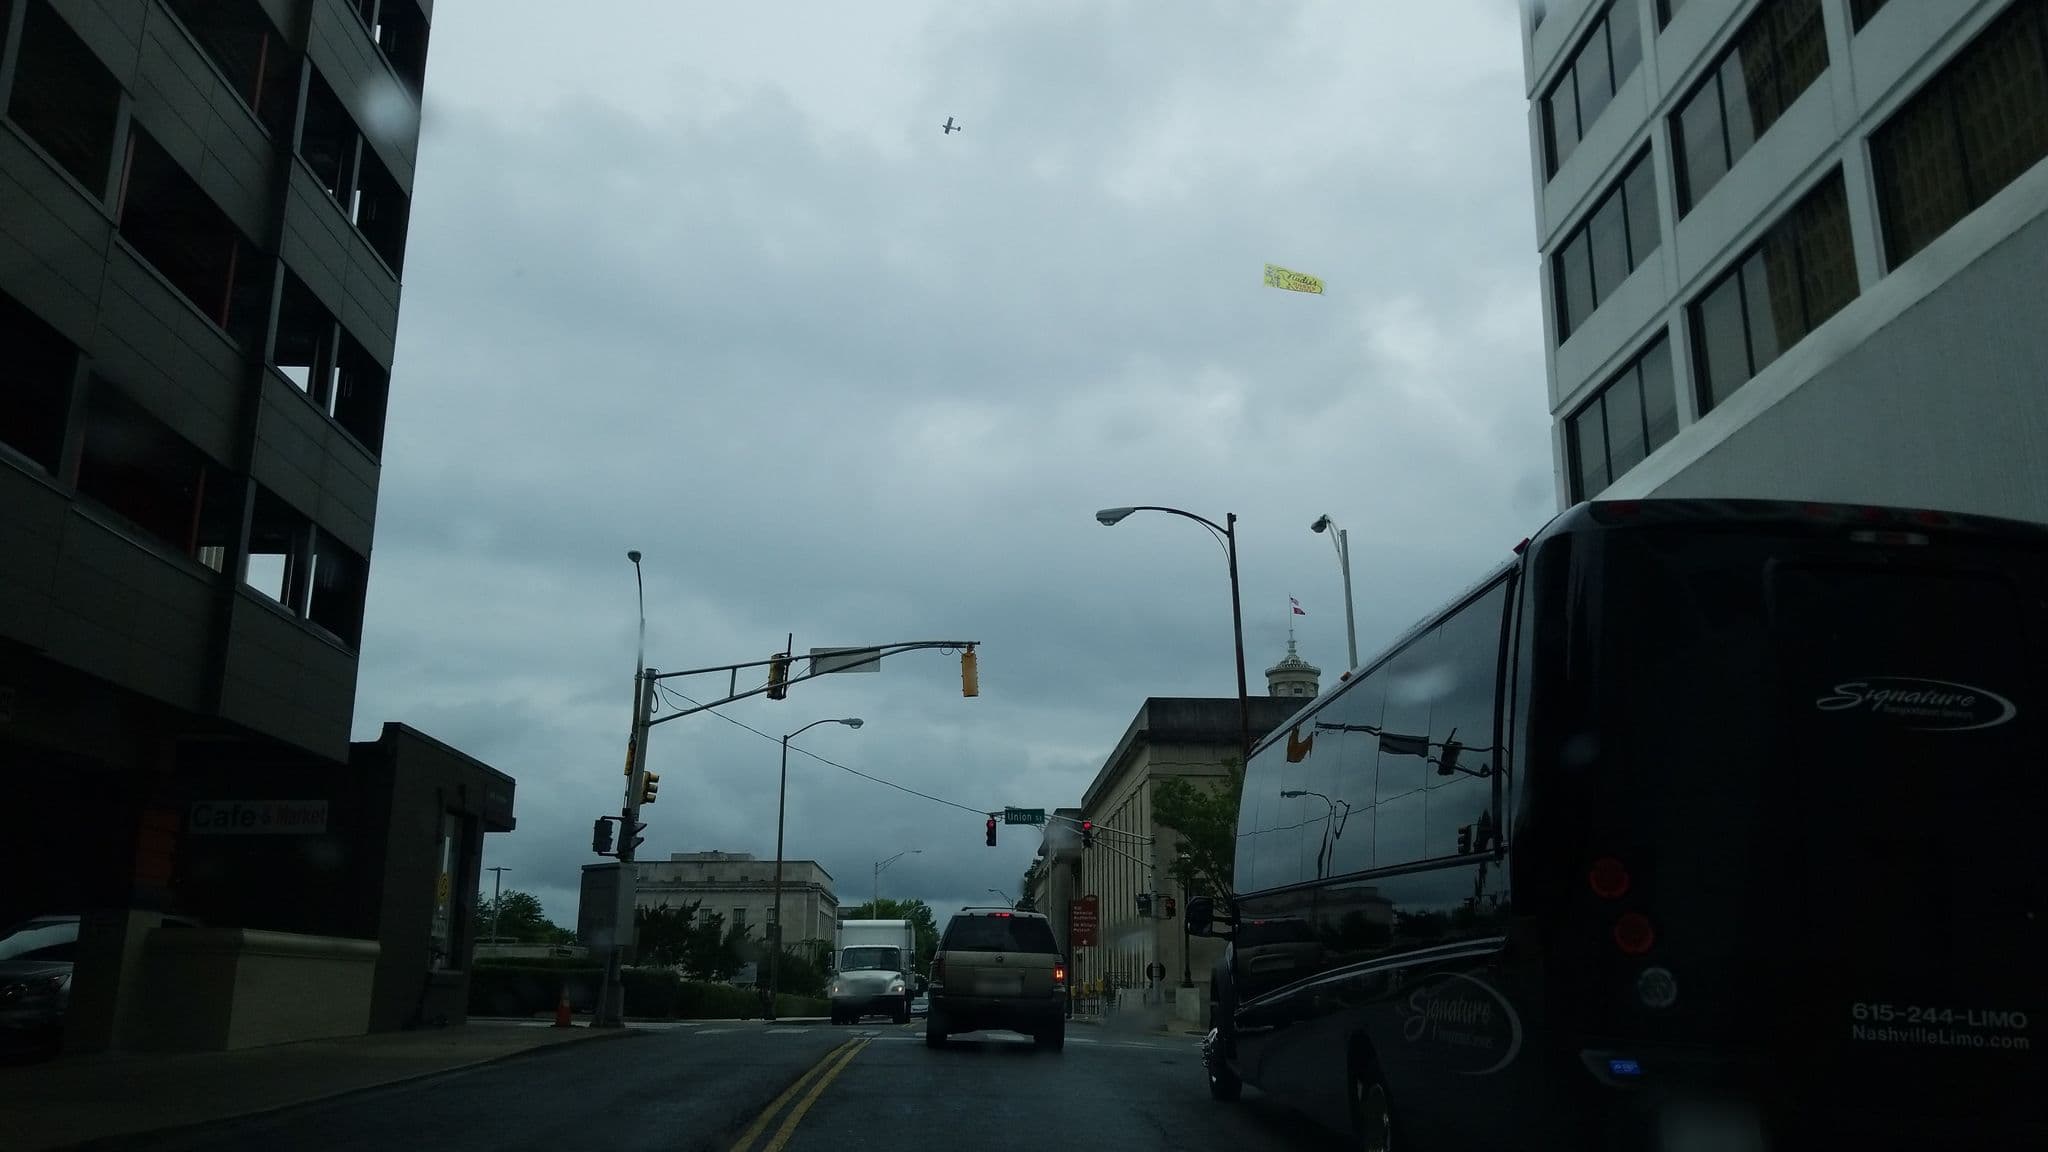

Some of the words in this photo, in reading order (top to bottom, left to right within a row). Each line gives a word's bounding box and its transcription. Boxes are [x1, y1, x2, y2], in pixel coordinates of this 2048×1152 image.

[1816, 682, 1976, 711] Signature
[193, 804, 256, 826] Cafe
[1007, 811, 1032, 822] Union
[1403, 986, 1492, 1042] Signature
[1852, 1002, 2028, 1029] 615-244-LIMO
[1852, 1024, 2031, 1049] NashvilleLimo.com
